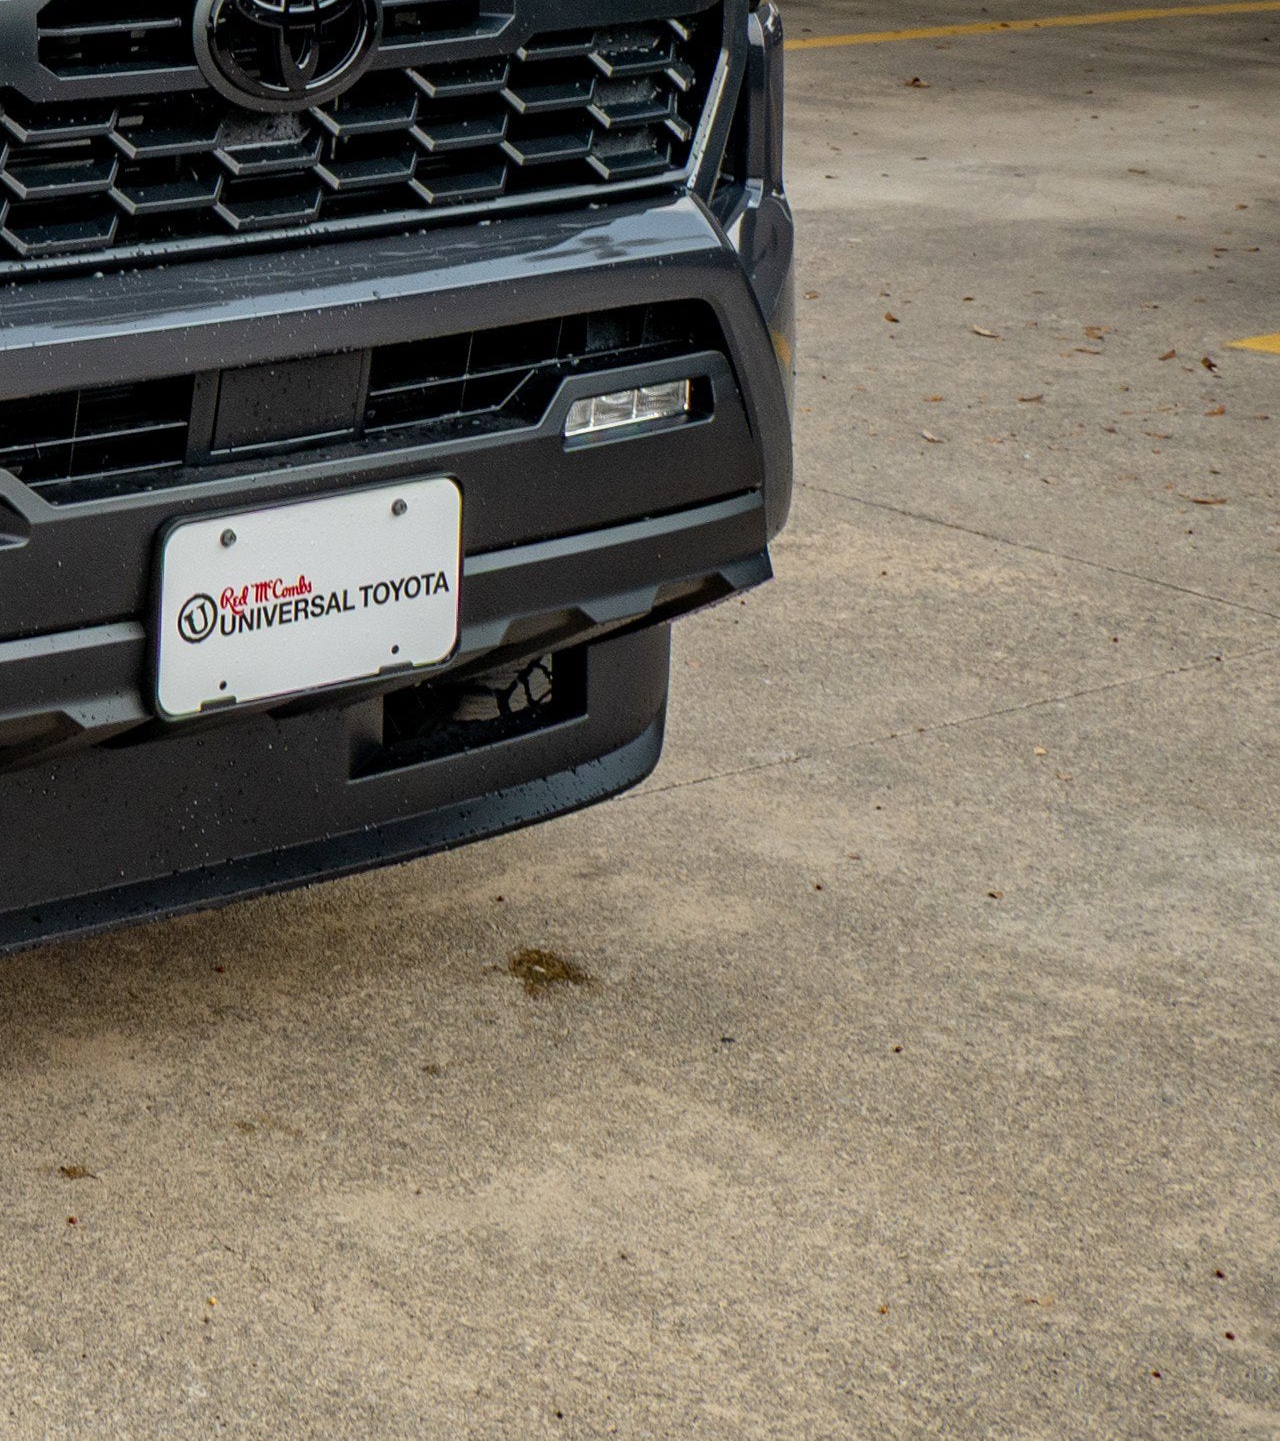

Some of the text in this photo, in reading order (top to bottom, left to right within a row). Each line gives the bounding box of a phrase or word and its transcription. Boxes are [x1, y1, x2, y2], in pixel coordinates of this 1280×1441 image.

[219, 584, 249, 616] Red
[219, 570, 450, 636] UNIVERSAL TOYOTA
